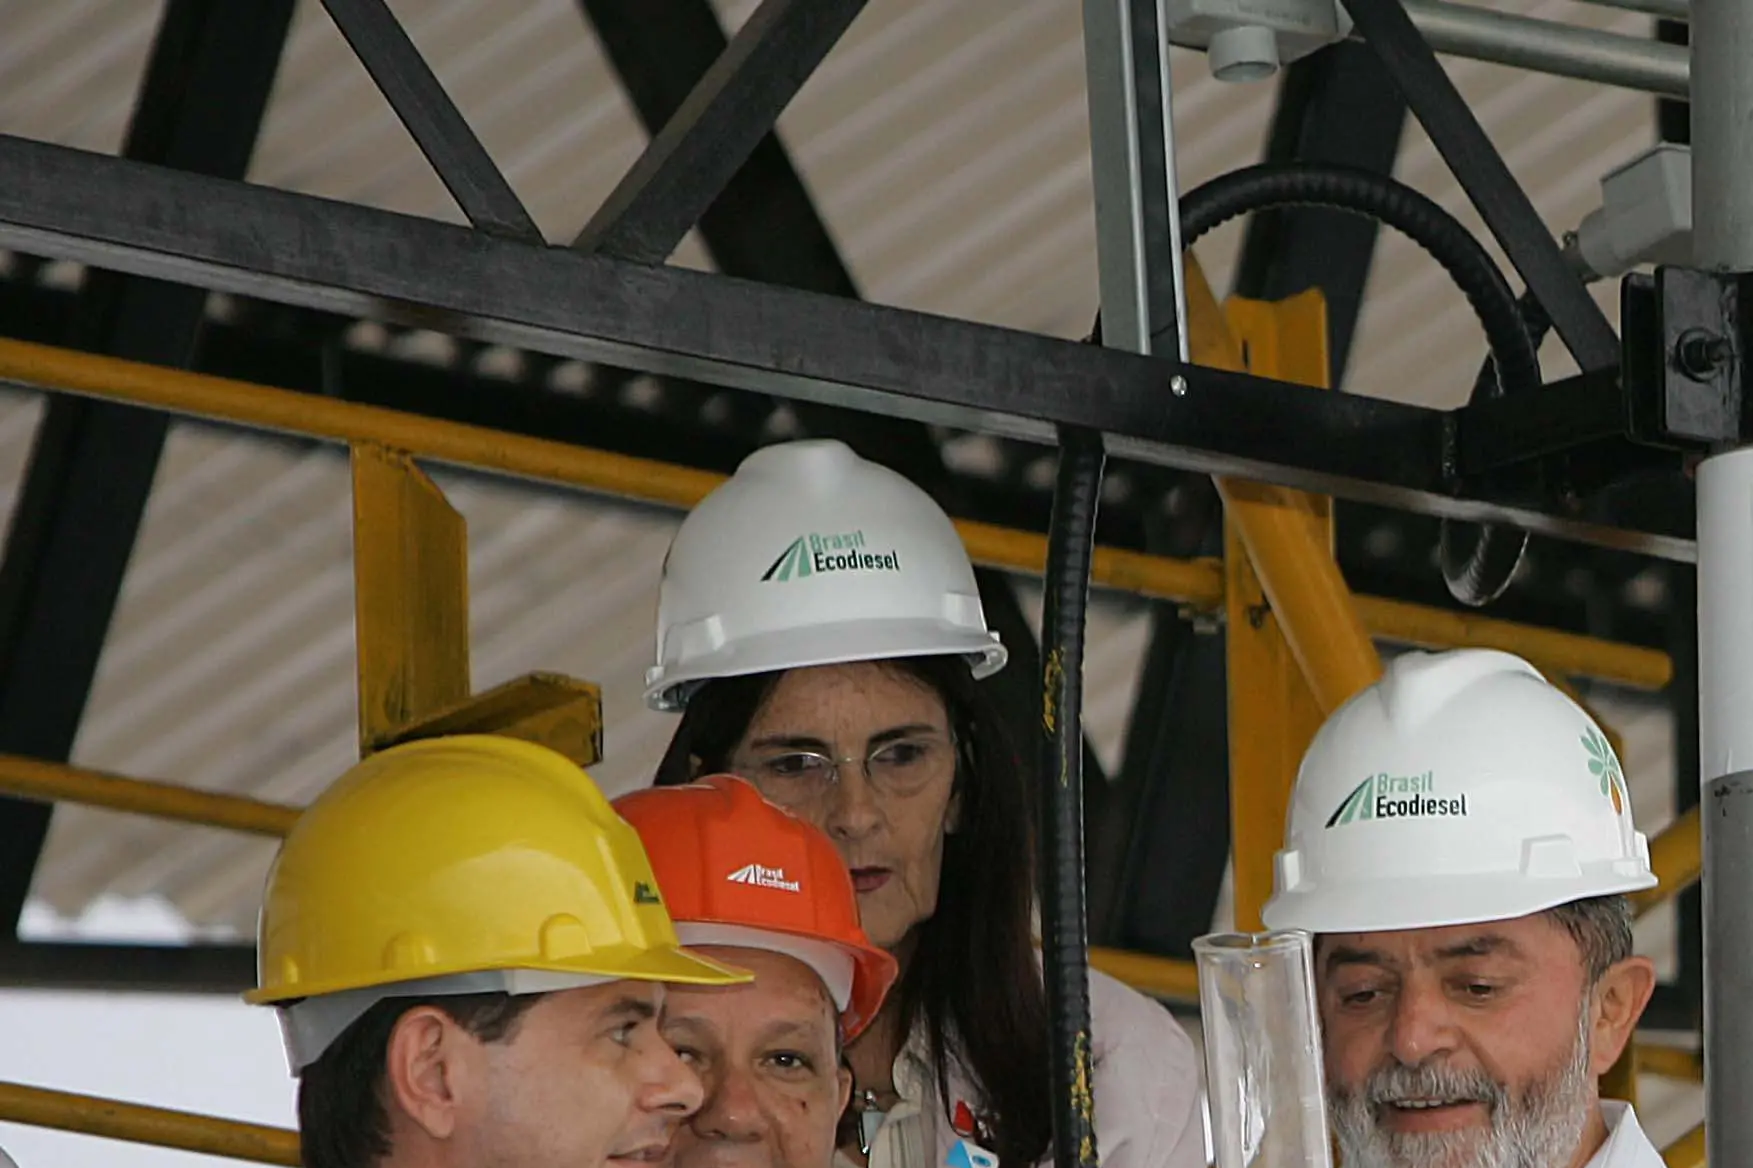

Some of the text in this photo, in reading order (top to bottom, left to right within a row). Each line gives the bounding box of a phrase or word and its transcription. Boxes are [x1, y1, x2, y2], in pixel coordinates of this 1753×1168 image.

[808, 530, 866, 551] Brasil
[814, 548, 900, 572] Ecodiesel
[1376, 770, 1434, 795] Brasil
[1375, 792, 1468, 819] Ecodiesel
